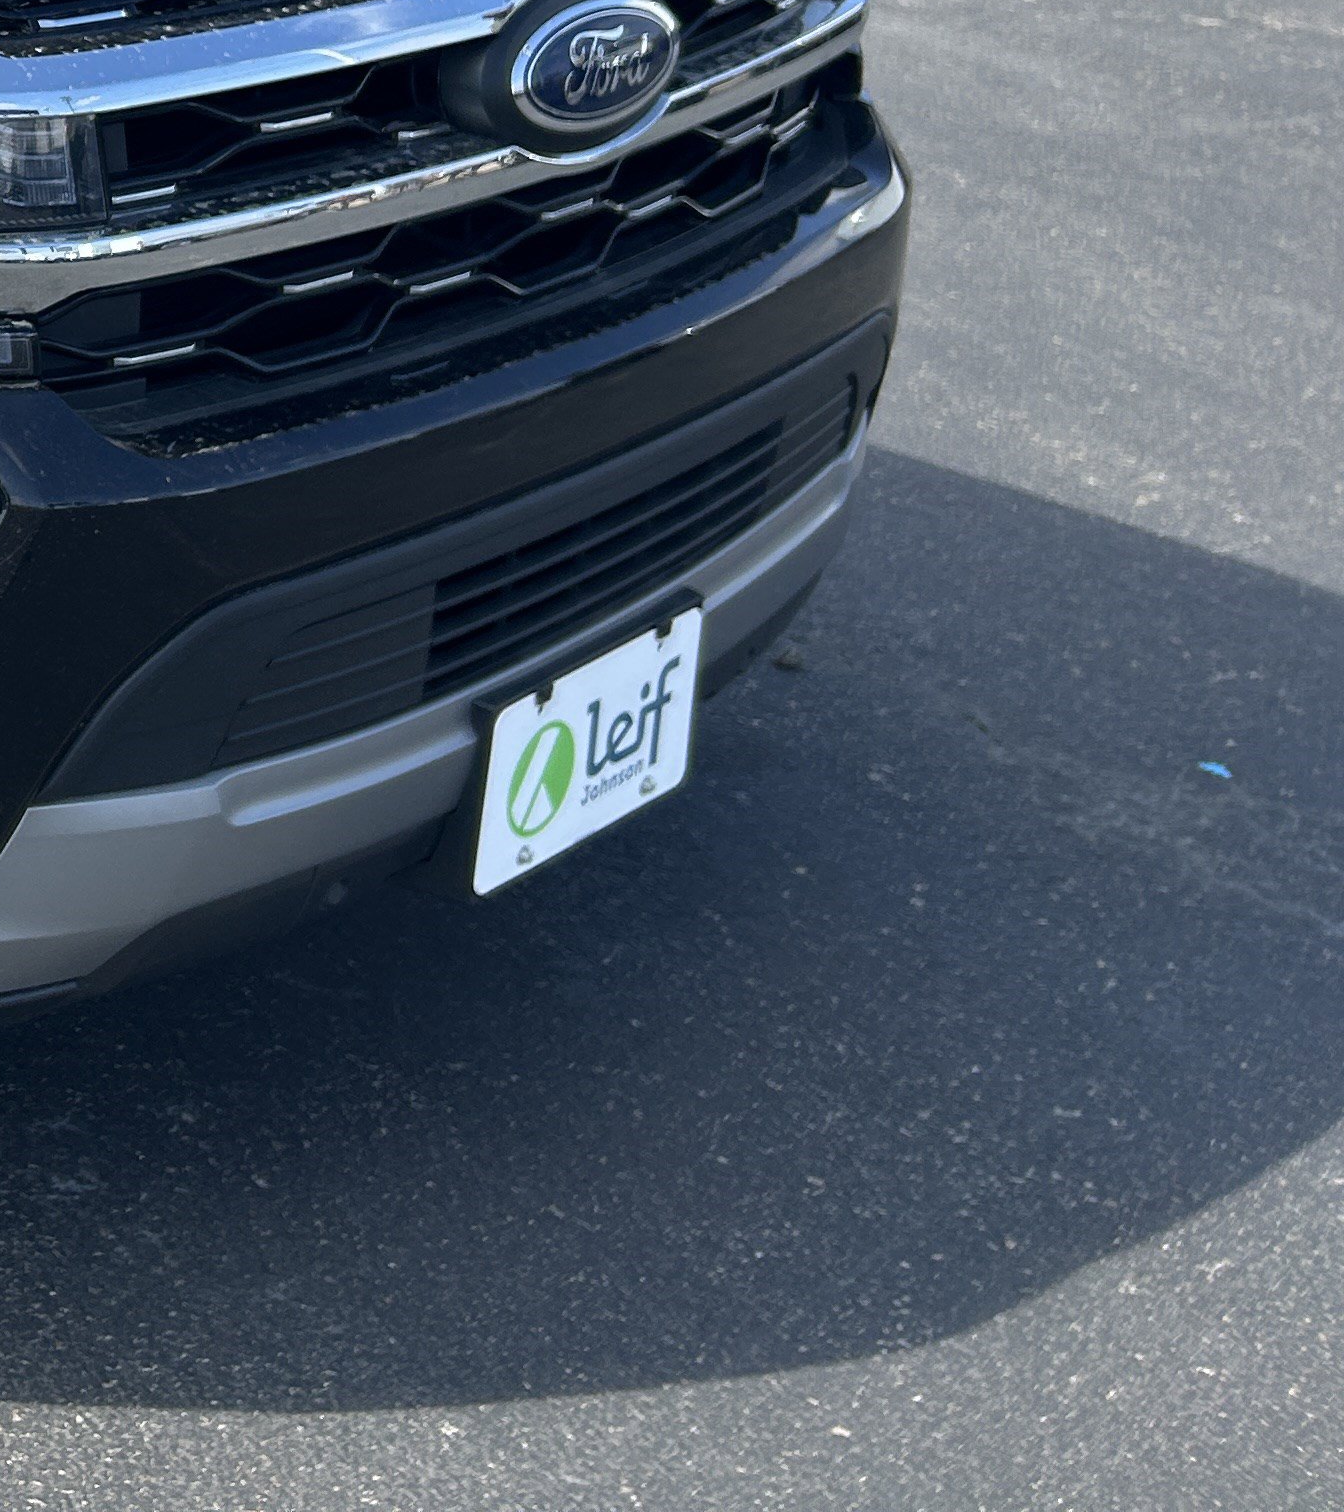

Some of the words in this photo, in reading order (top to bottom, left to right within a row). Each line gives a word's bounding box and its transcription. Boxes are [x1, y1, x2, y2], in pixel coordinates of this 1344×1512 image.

[564, 24, 650, 106] Ford
[585, 654, 681, 778] leif
[580, 758, 645, 807] Johnson
